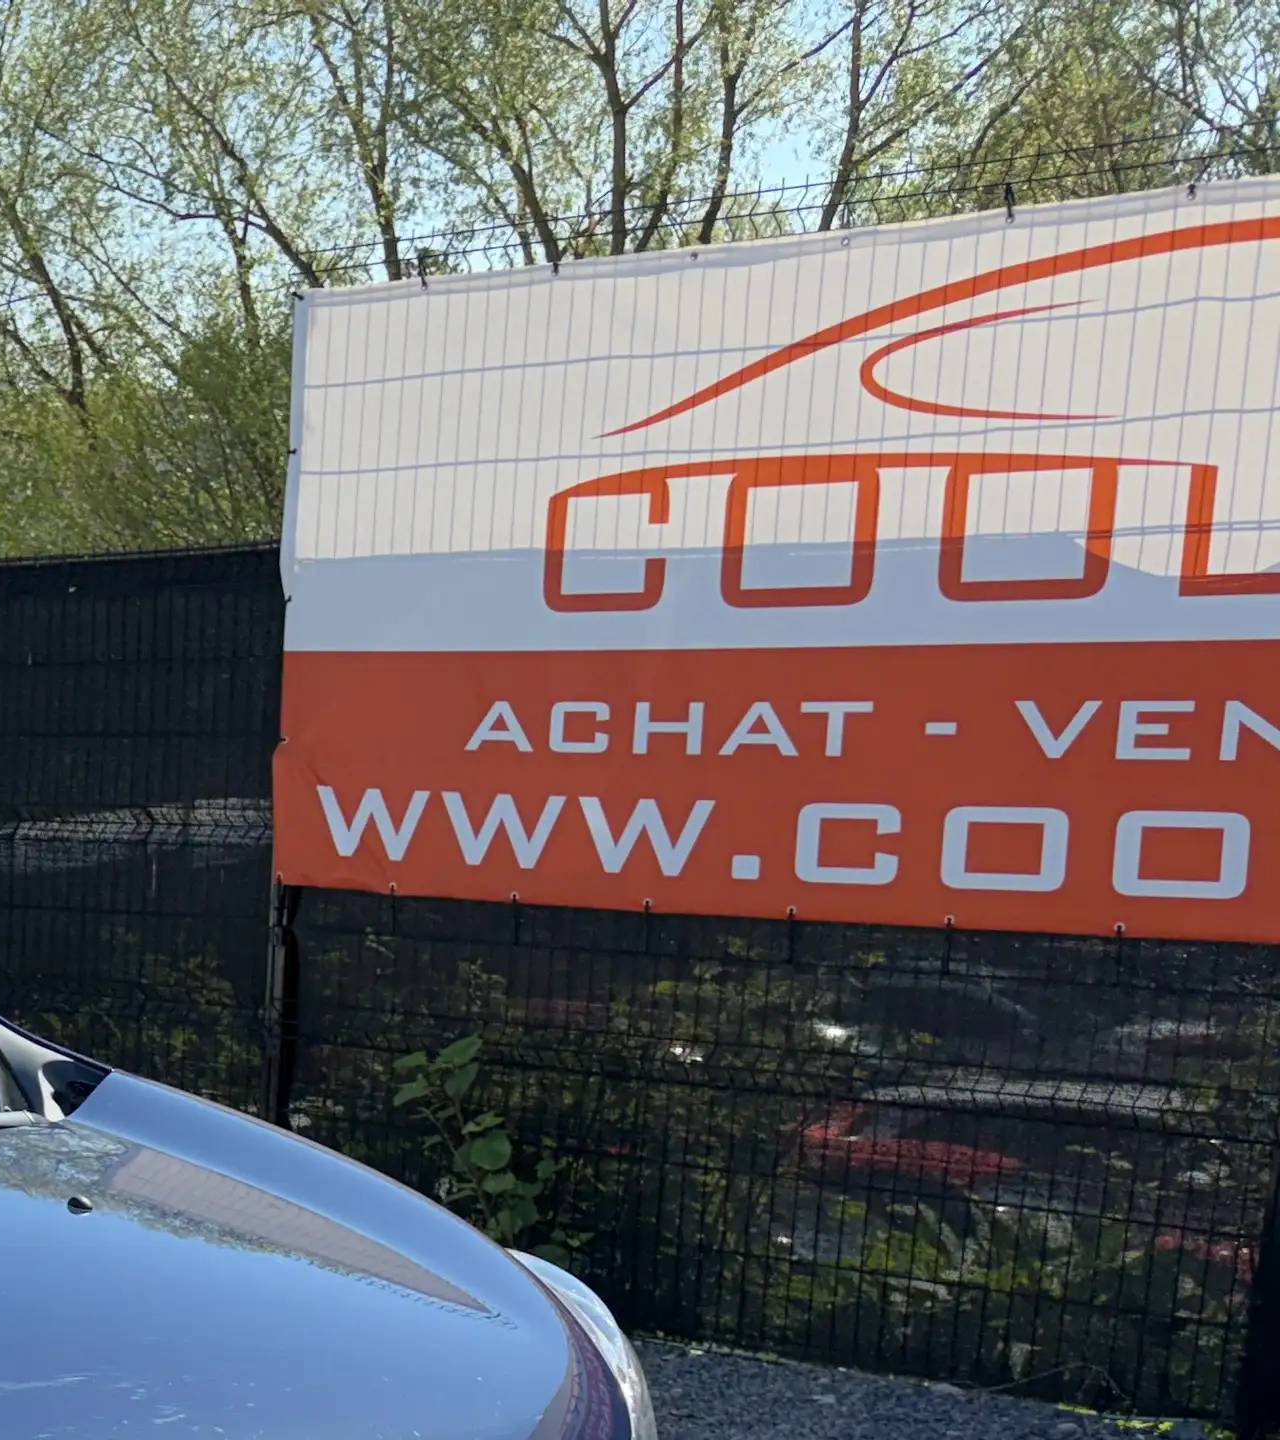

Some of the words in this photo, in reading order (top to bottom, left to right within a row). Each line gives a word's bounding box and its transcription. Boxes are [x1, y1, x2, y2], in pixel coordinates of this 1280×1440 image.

[543, 452, 1280, 613] COOL
[464, 700, 874, 758] ACHAT
[1014, 700, 1280, 762] VEN
[316, 785, 1252, 901] WWW.COO
